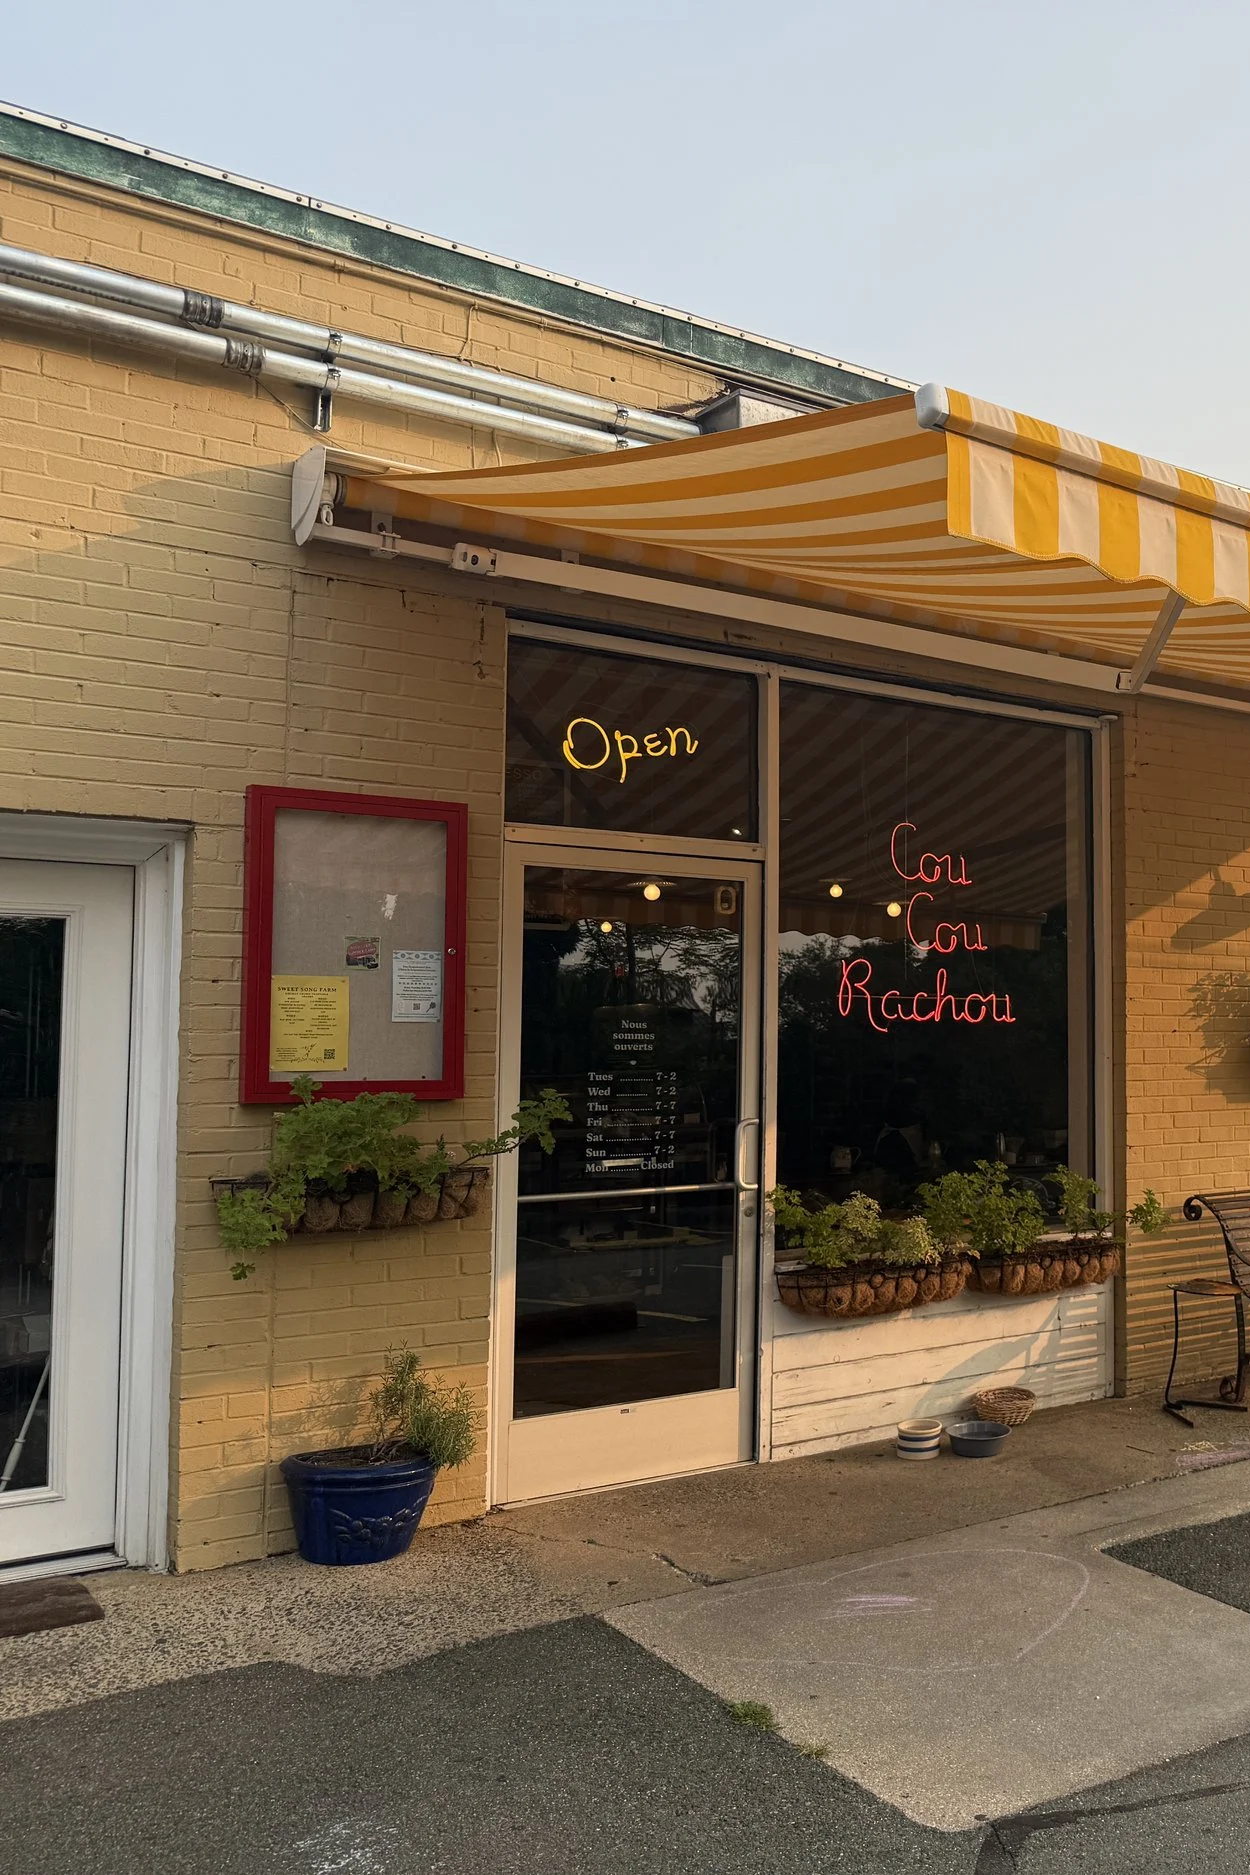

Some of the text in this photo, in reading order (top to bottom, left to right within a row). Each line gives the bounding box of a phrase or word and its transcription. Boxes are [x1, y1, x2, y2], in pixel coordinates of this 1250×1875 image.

[562, 716, 699, 783] Open
[506, 767, 543, 780] SSO
[890, 822, 973, 885] Cou
[906, 891, 989, 953] Cou
[837, 958, 1017, 1032] Rachou
[621, 1019, 648, 1029] Nous
[612, 1032, 656, 1040] sommes
[614, 1043, 654, 1051] ouverts
[587, 1071, 614, 1081] Tues
[587, 1086, 611, 1097] Wed
[587, 1102, 609, 1112] Thu
[586, 1117, 603, 1127] Fri
[586, 1132, 604, 1142] Sat
[585, 1148, 607, 1157] Sun
[585, 1159, 675, 1173] Mon Closed
